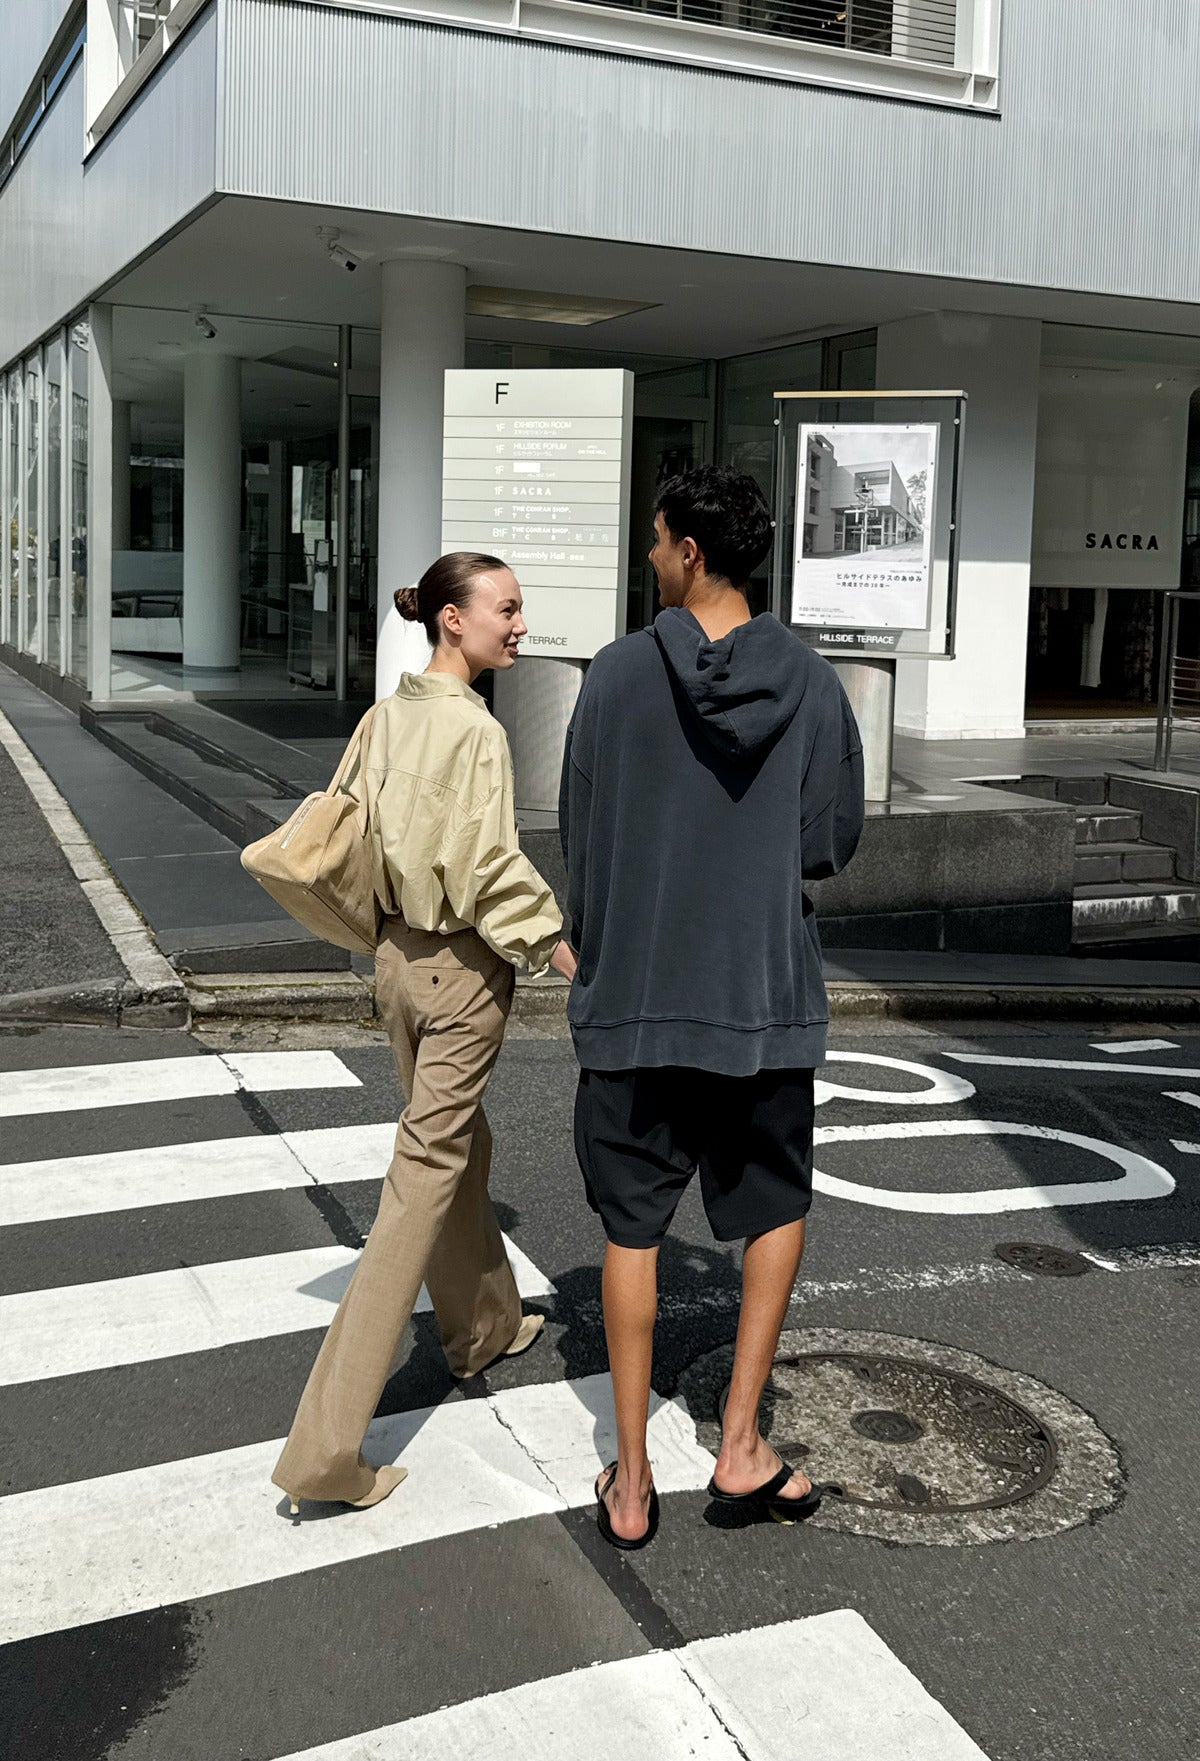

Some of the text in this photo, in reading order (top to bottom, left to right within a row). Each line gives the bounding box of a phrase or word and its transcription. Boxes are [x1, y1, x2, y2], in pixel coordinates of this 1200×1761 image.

[496, 383, 509, 404] F
[512, 486, 552, 496] SACRA
[1085, 533, 1159, 550] SACRA
[511, 550, 548, 561] Assembly
[528, 635, 568, 646] TERRACE
[819, 633, 895, 645] HILLSIDE TERRACE
